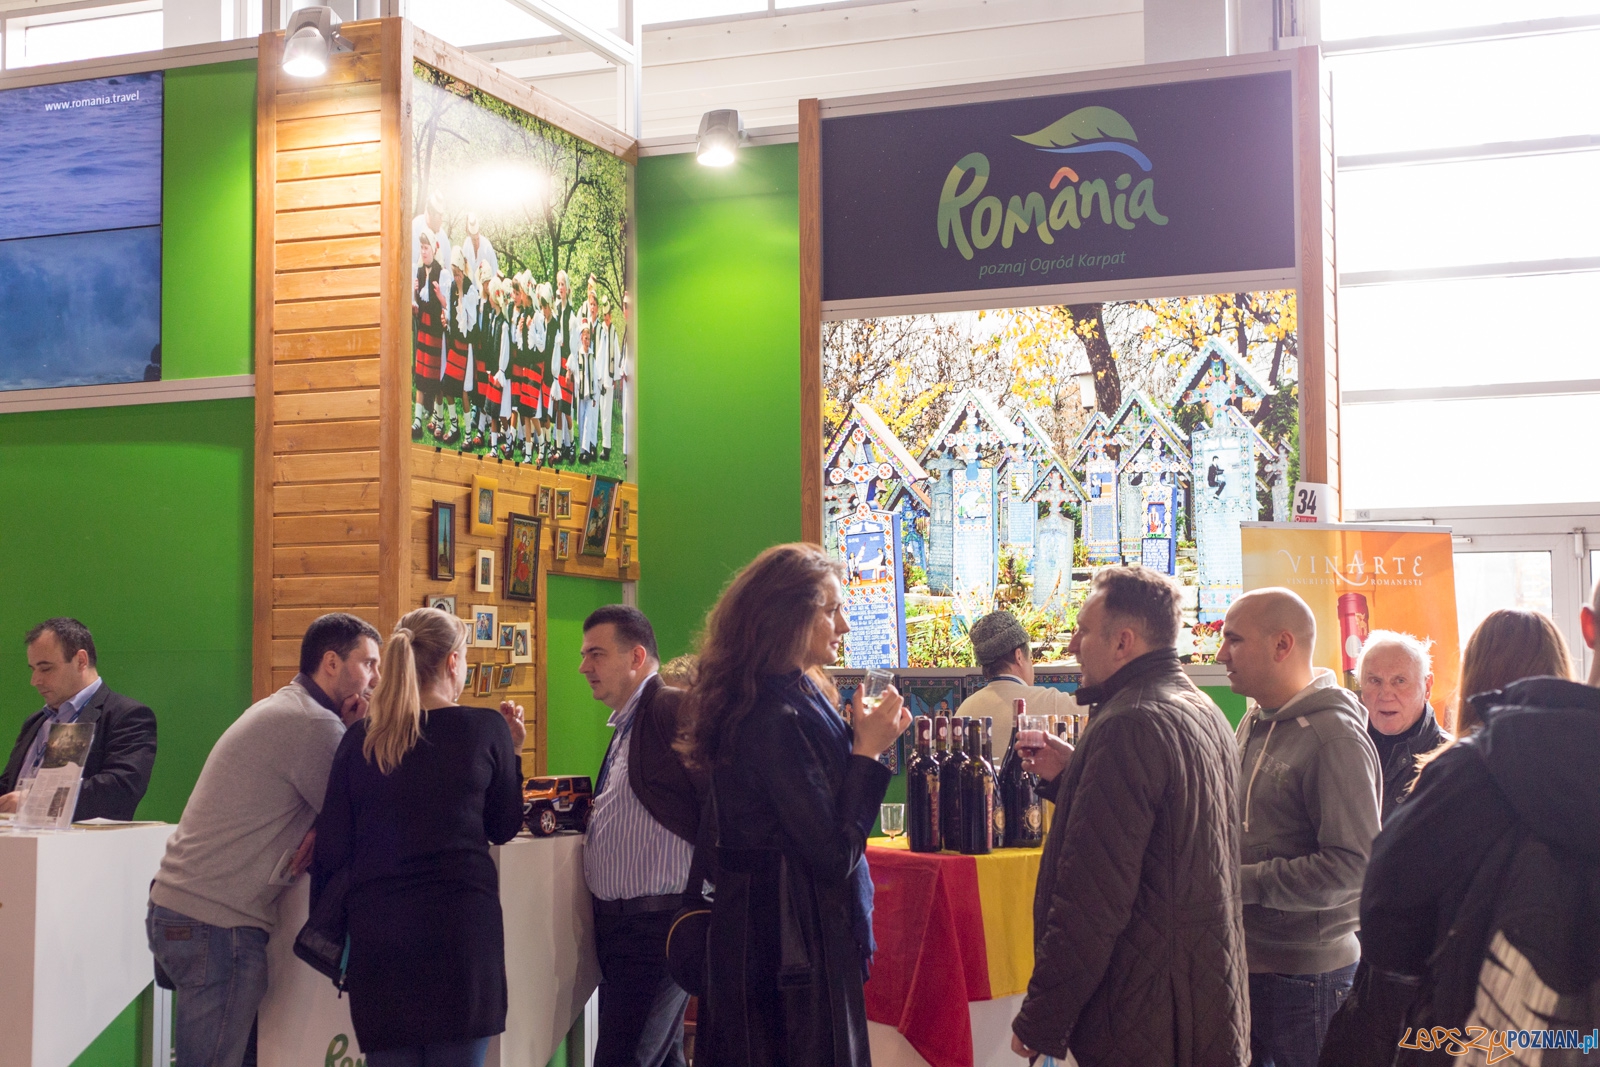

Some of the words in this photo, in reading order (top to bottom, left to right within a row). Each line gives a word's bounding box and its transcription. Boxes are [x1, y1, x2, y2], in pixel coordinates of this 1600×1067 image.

[44, 89, 140, 111] www.romania.travel
[936, 152, 1169, 261] România
[978, 258, 1027, 280] poznaj
[1030, 253, 1075, 275] Ogród
[1078, 250, 1127, 270] Karpat
[1296, 488, 1317, 515] 34
[1370, 578, 1422, 587] ROMANESTI
